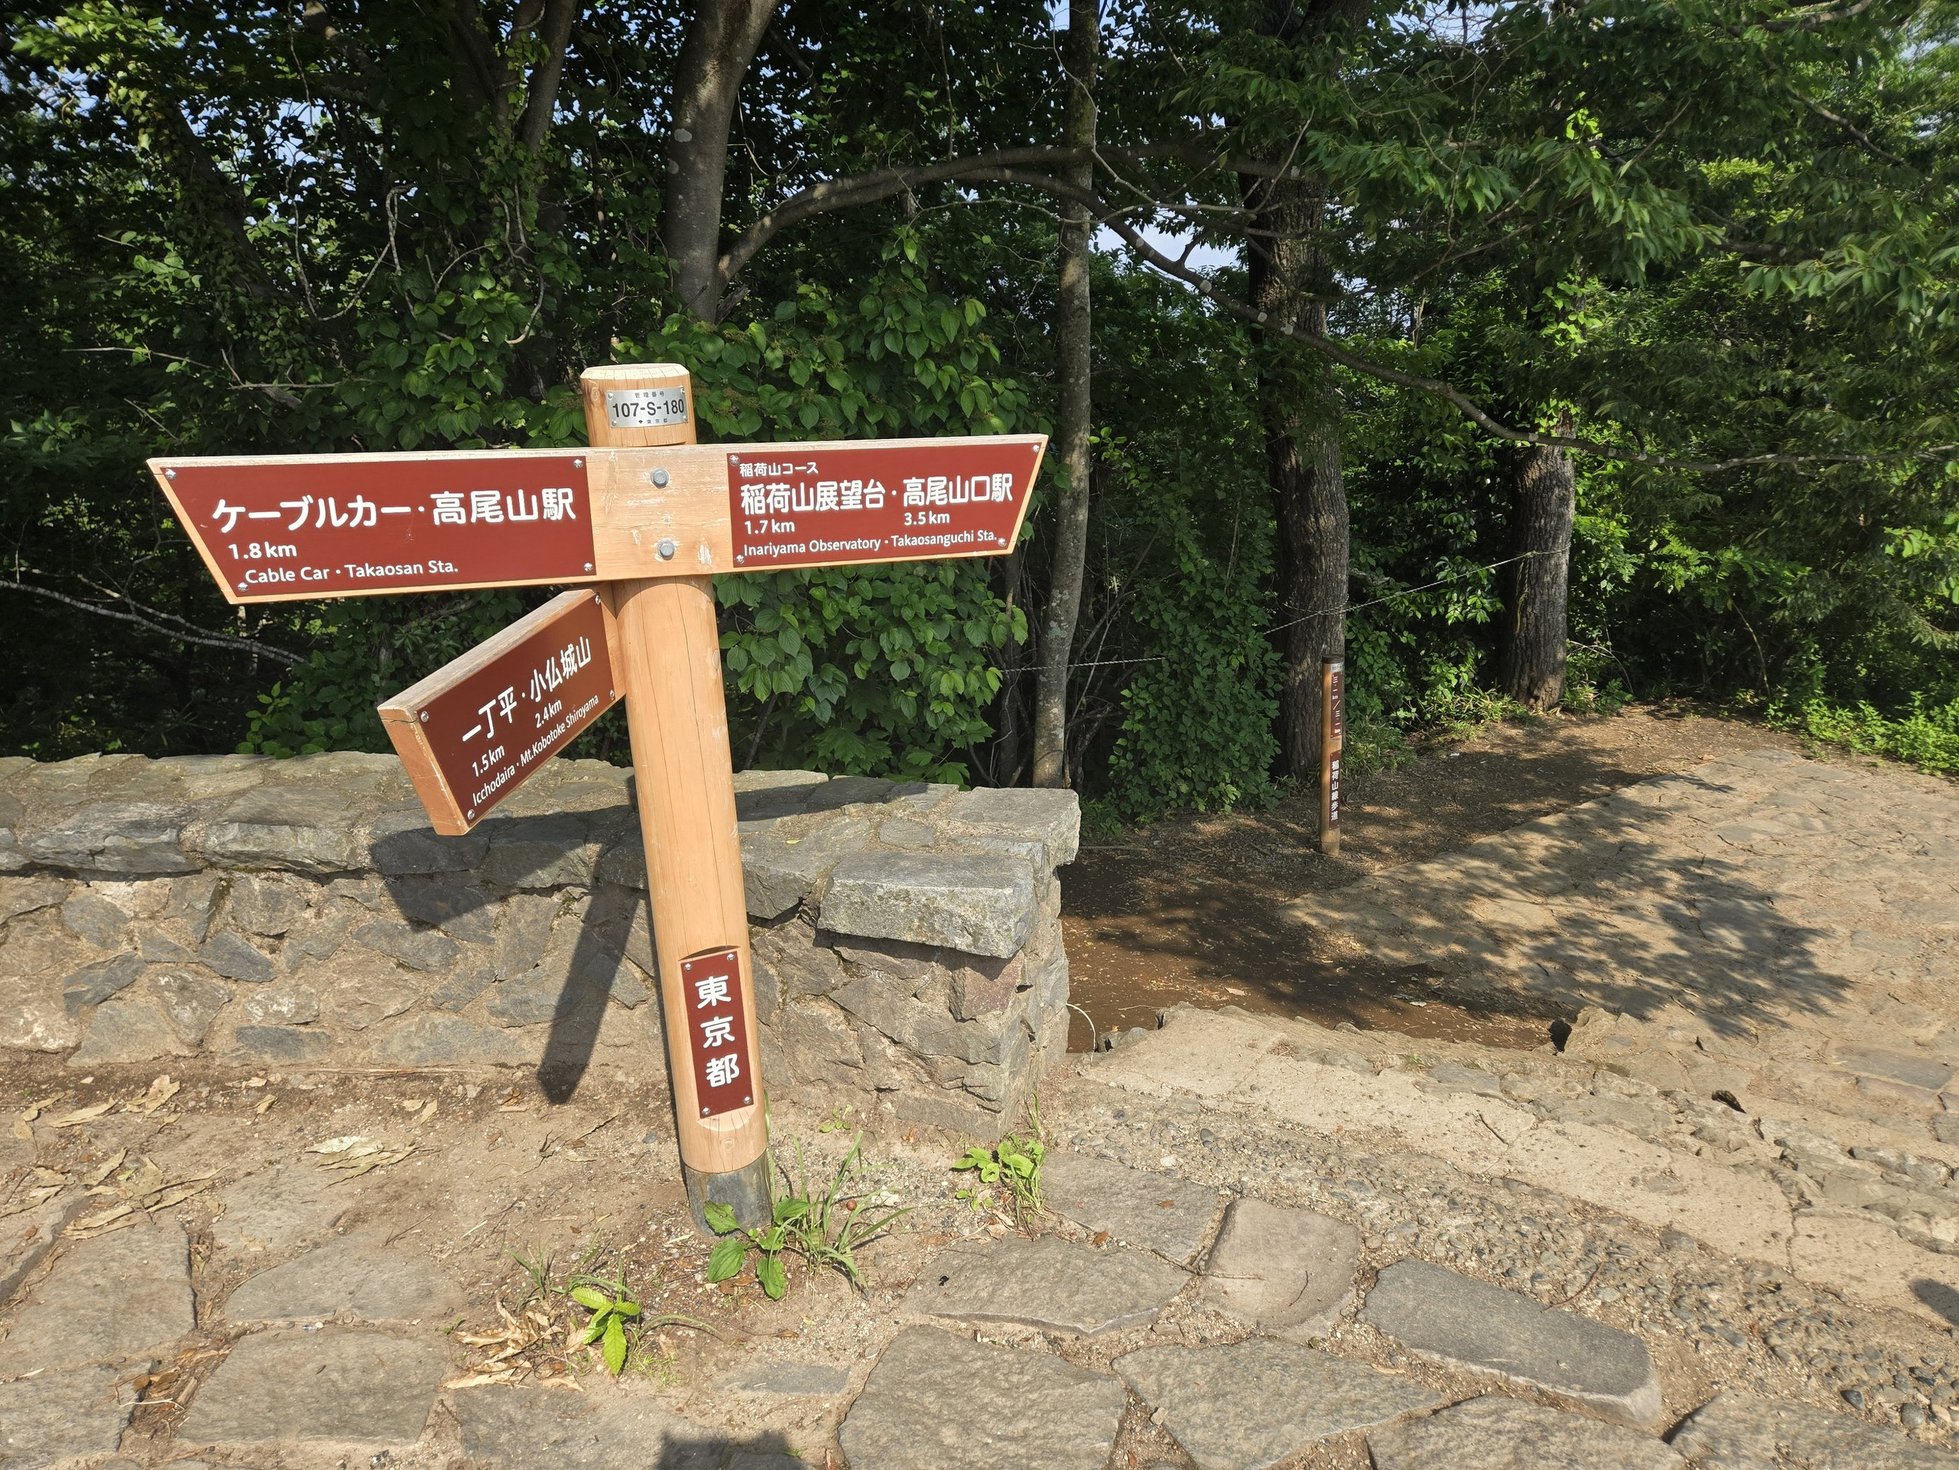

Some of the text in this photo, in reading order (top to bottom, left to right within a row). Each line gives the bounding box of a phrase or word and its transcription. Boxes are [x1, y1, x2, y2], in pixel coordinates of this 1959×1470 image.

[612, 399, 685, 418] 107-S-180
[739, 461, 819, 477] 稲荷山コース
[212, 487, 577, 534] ケーブルカー・高尾山駅
[740, 473, 1013, 515] 稲荷山展望台・高尾山口駅
[744, 529, 998, 558] Inariyama Observatory Takaosanguchi Sta.
[245, 559, 459, 584] Cable Car Takaosan Sta.
[462, 636, 592, 742] 一丁平・小仏城山
[472, 765, 516, 806] Icchodaira
[565, 694, 599, 729] Shiroyama
[695, 975, 740, 1087] 東京都
